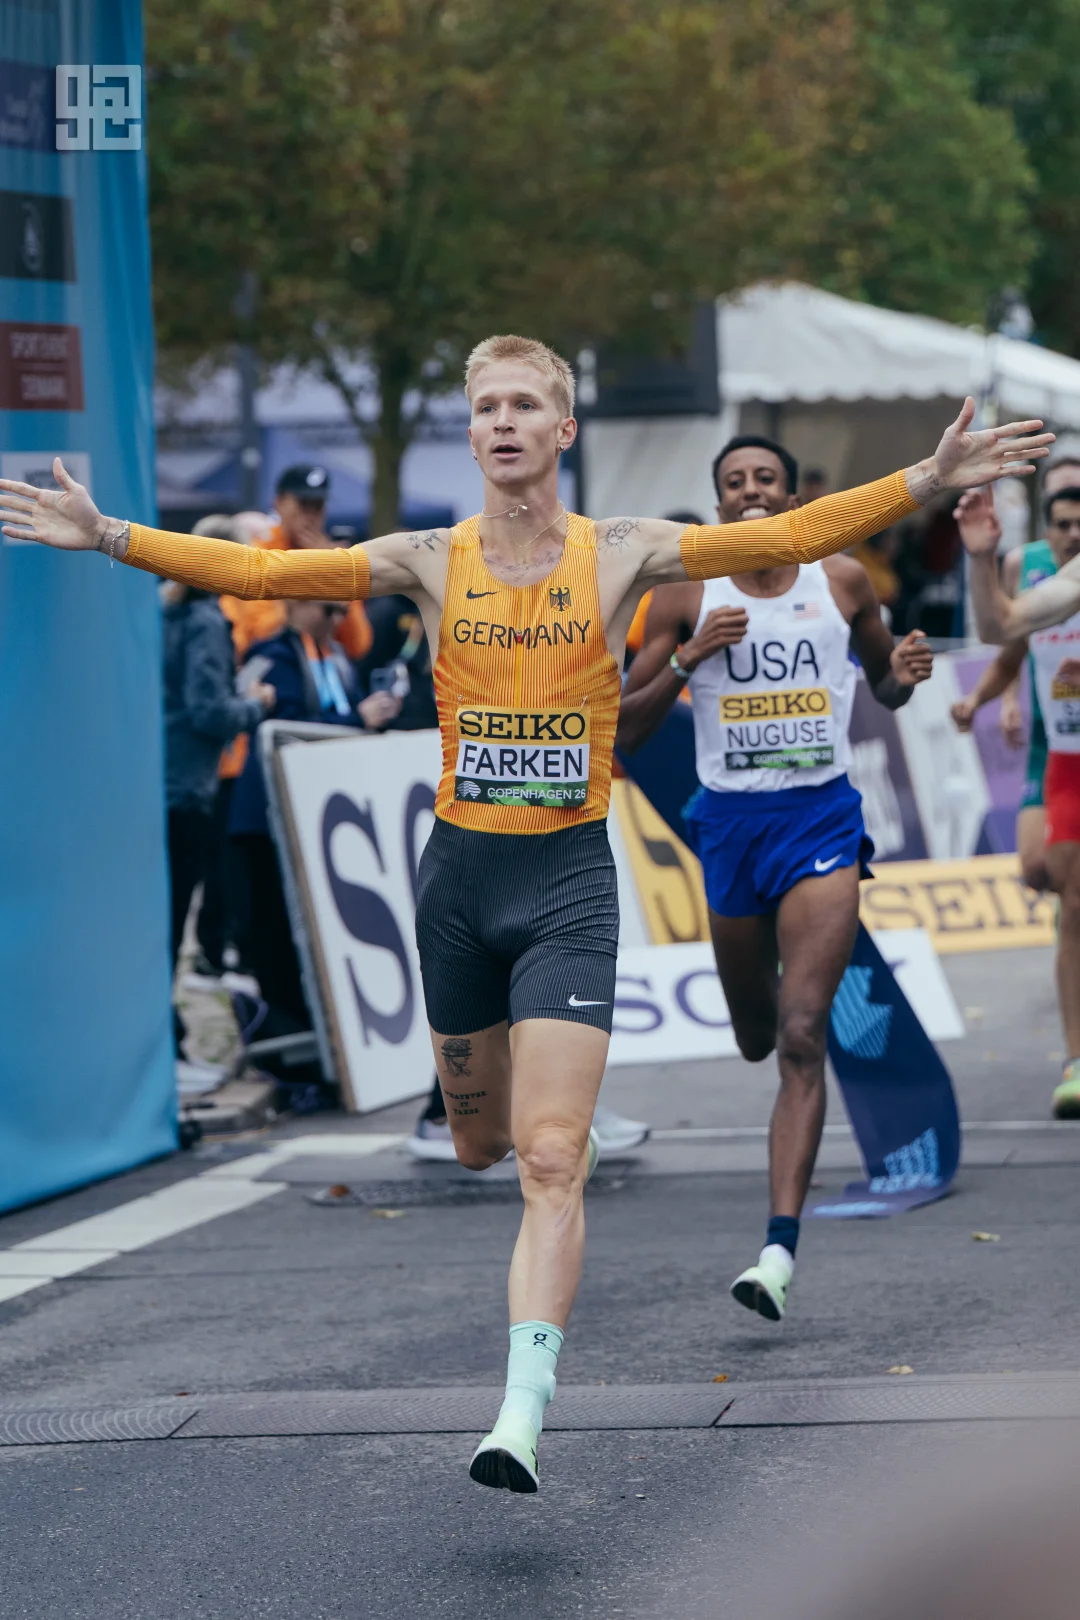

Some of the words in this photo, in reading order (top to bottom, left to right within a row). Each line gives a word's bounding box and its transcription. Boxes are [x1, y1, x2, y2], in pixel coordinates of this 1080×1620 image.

[453, 618, 591, 650] GERMANY
[725, 639, 820, 683] USA
[722, 691, 827, 720] SEIKO
[458, 710, 586, 741] SEIKO
[727, 720, 828, 749] NUGUSE
[461, 744, 583, 778] FARKEN
[487, 786, 572, 800] COPENHAGEN
[574, 788, 586, 800] 26
